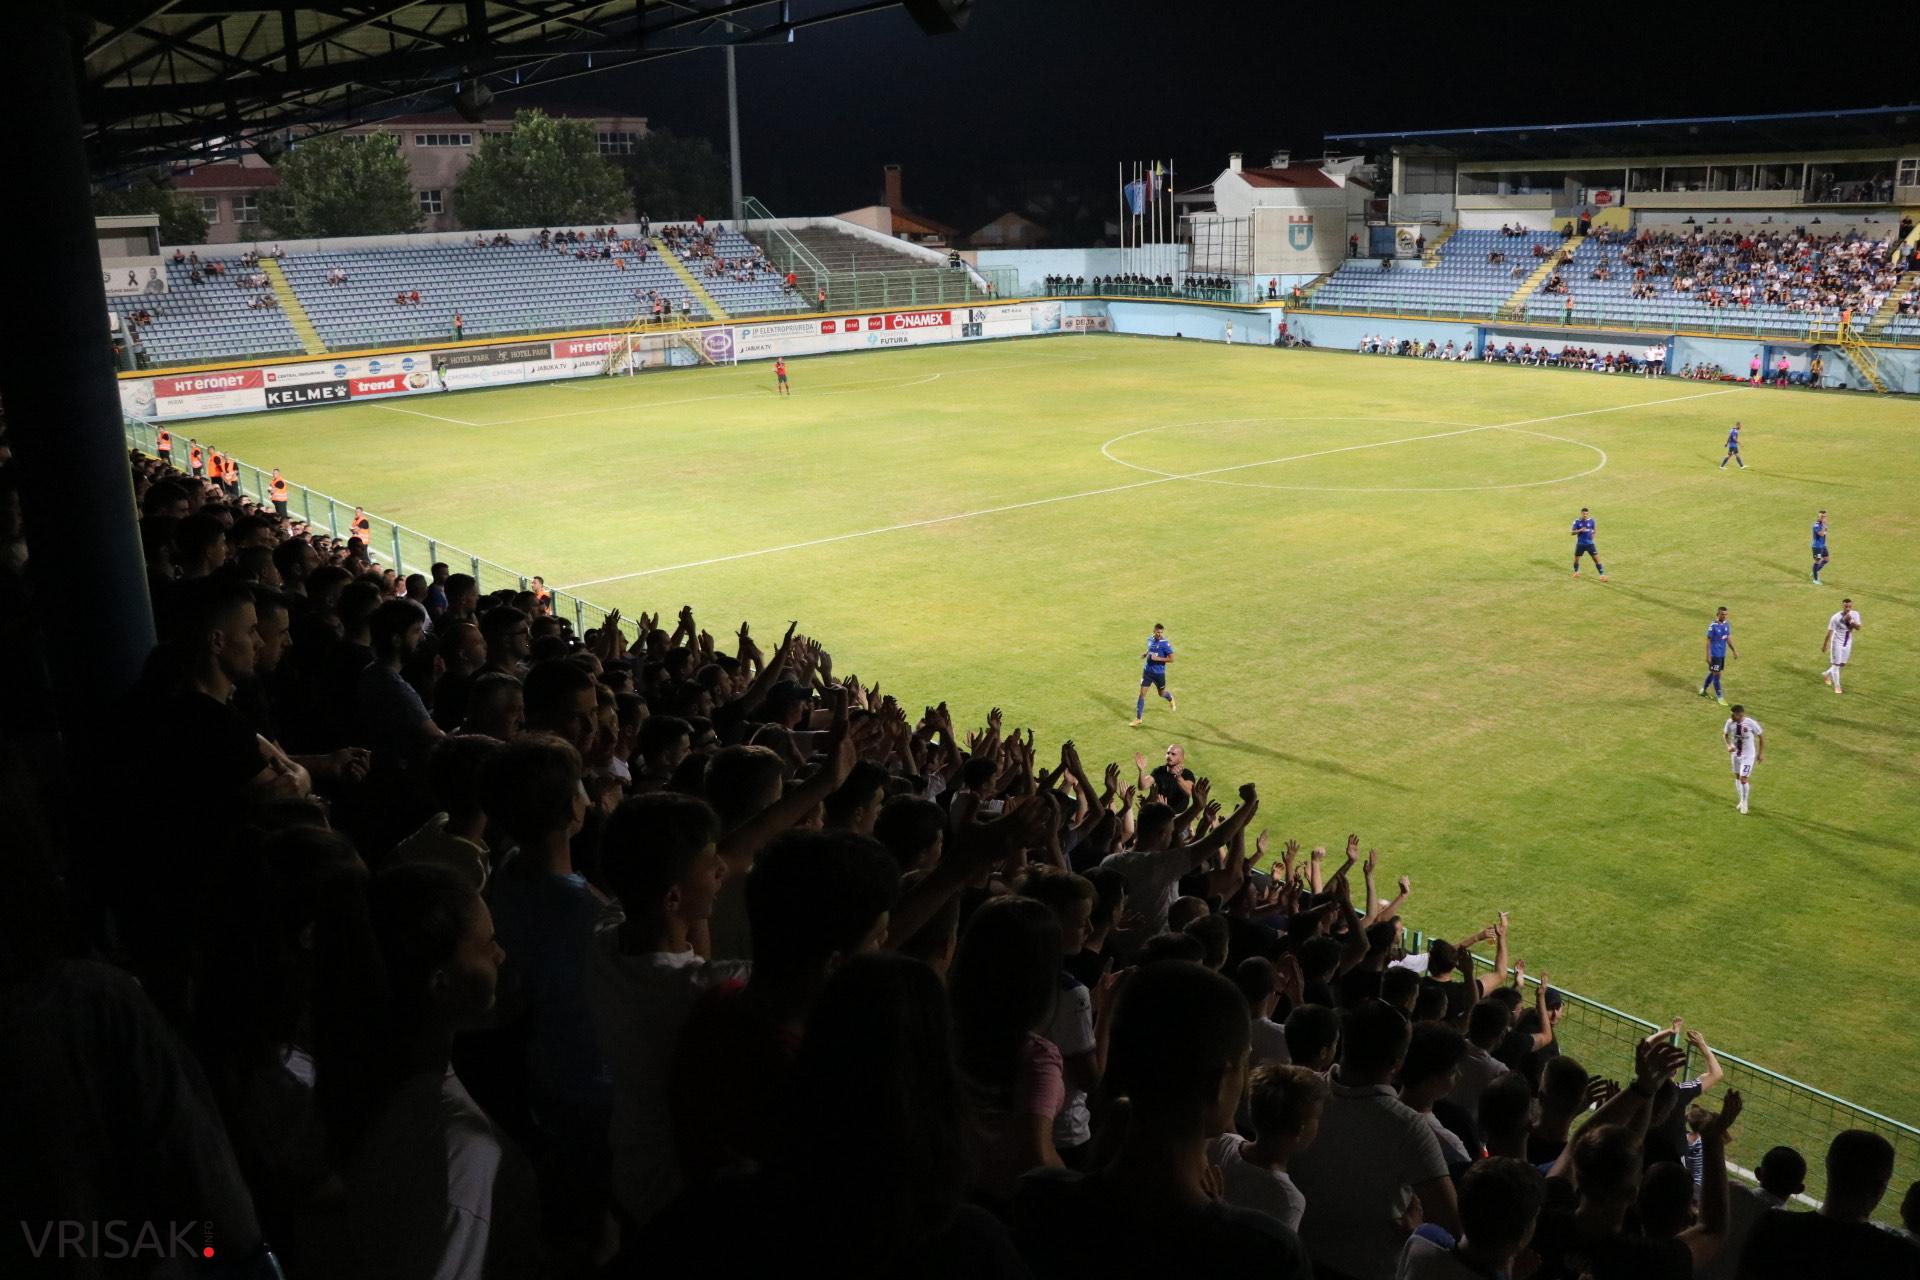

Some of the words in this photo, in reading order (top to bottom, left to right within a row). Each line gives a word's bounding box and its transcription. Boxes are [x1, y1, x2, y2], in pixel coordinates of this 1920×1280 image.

[905, 313, 943, 327] NAMEX
[880, 336, 909, 345] FUTURA
[511, 350, 532, 359] HOTEL
[532, 348, 548, 356] PARK
[569, 344, 584, 354] HT
[450, 355, 472, 364] HOTEL
[473, 353, 490, 362] PARK
[175, 380, 193, 392] HT
[358, 378, 396, 392] trend
[267, 387, 333, 405] KELME
